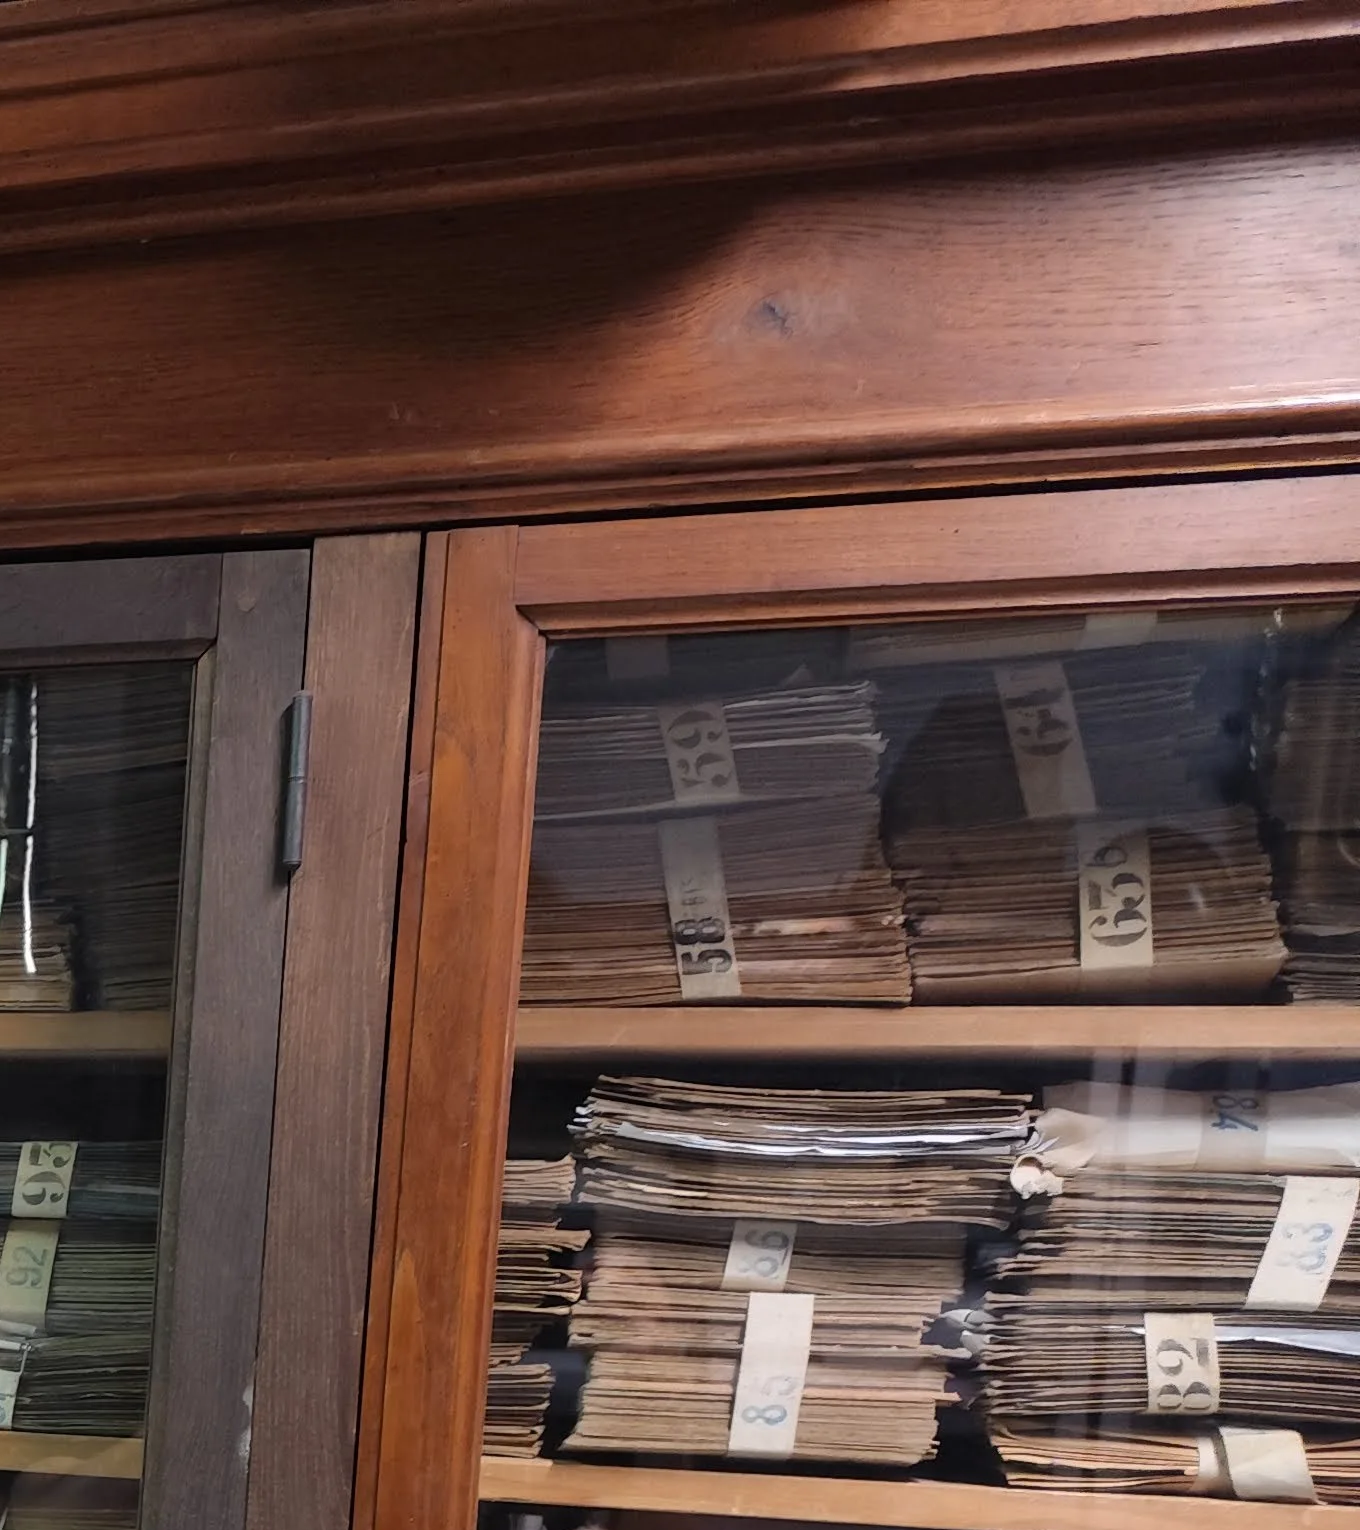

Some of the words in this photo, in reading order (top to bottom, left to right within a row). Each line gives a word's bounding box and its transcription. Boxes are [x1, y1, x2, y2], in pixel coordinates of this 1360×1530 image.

[675, 916, 733, 975] 58
[21, 1141, 75, 1206] 93
[5, 1245, 48, 1288] 92
[1156, 1338, 1211, 1410] 82
